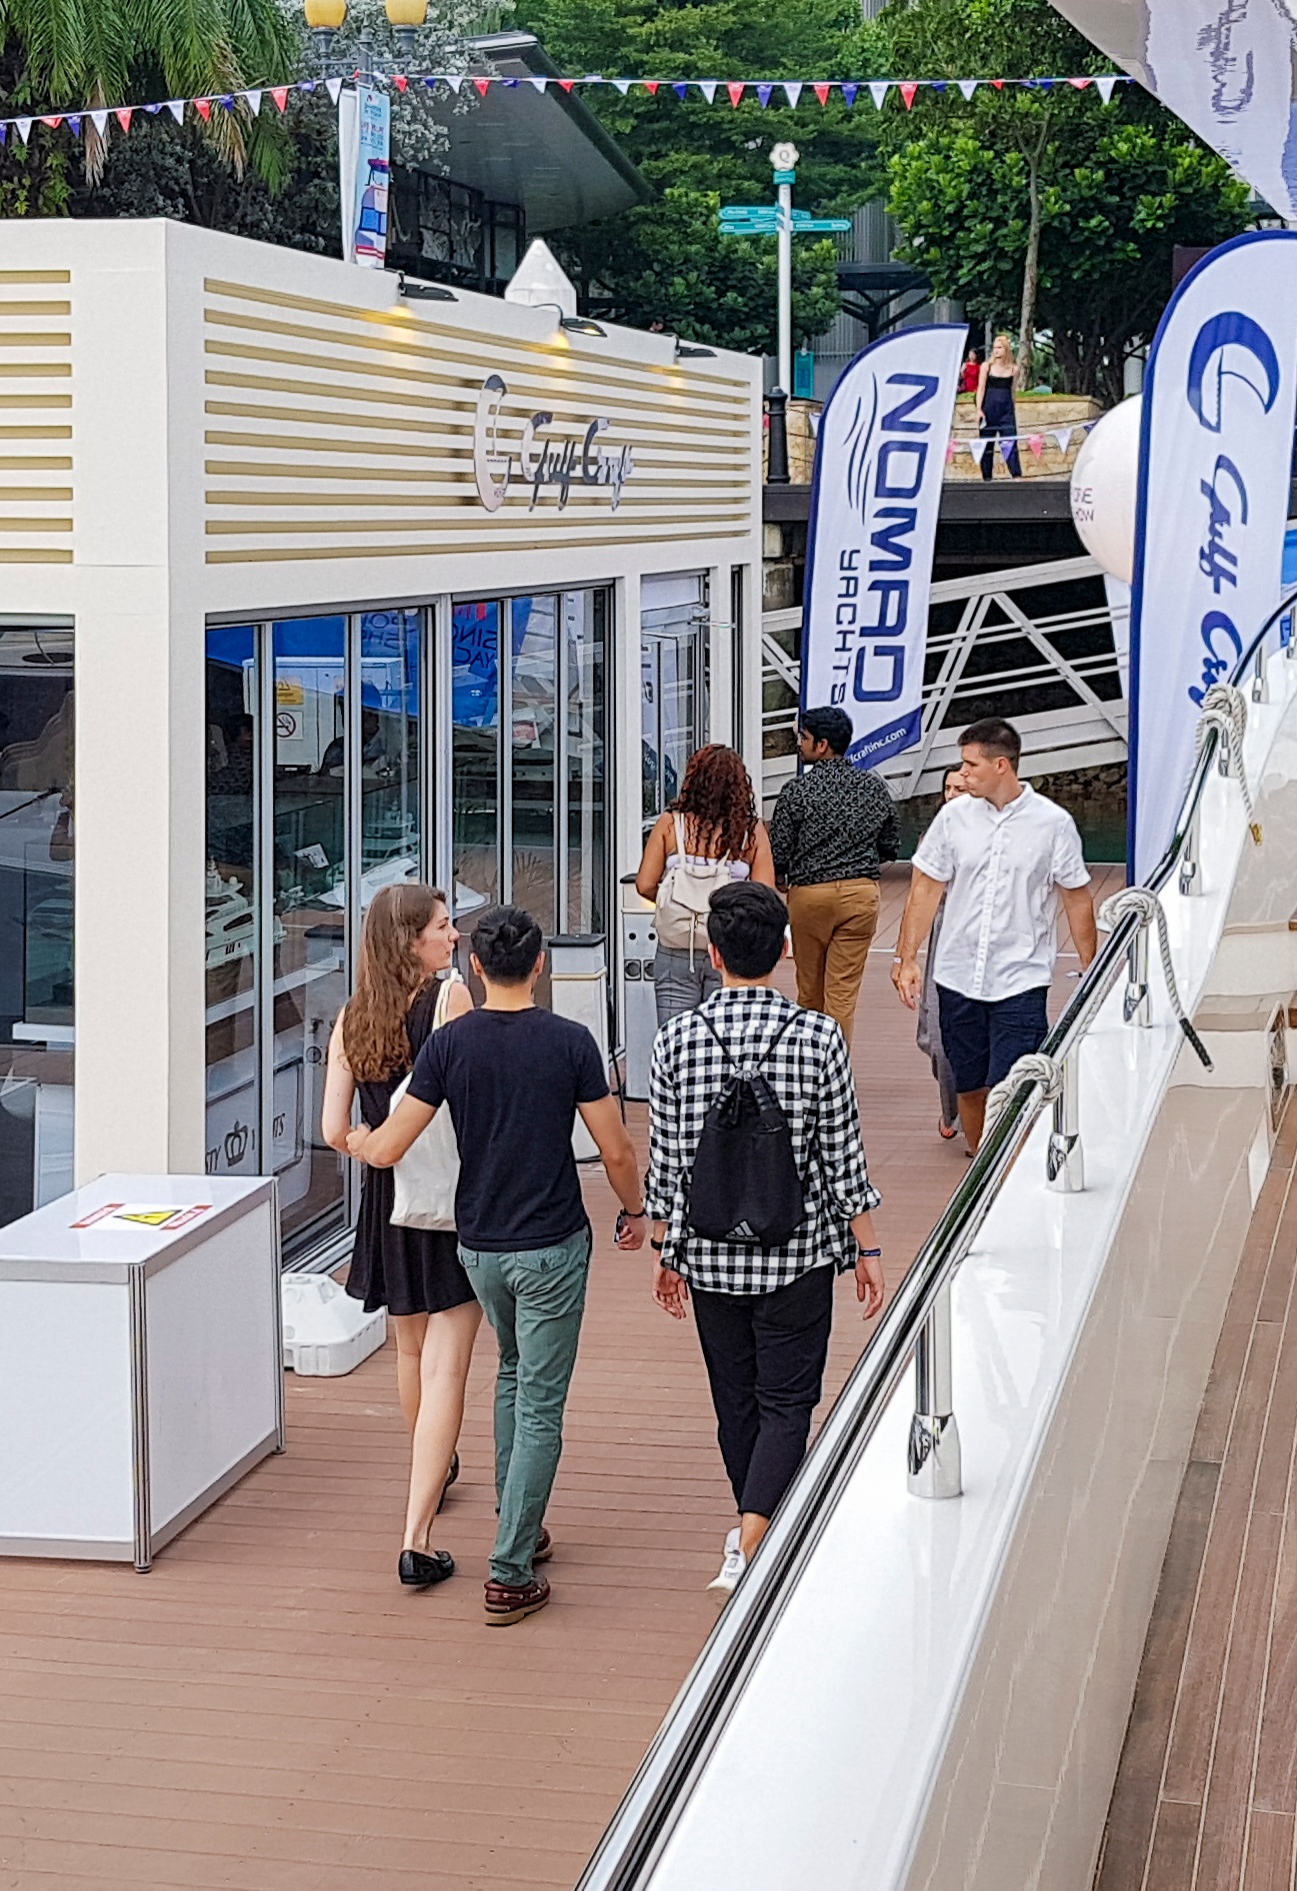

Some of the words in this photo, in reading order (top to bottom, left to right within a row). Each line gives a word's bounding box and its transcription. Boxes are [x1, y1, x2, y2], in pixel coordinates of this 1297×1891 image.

[853, 372, 939, 703] NOMAD
[1199, 453, 1249, 595] Gulf
[830, 548, 861, 705] YACHTS
